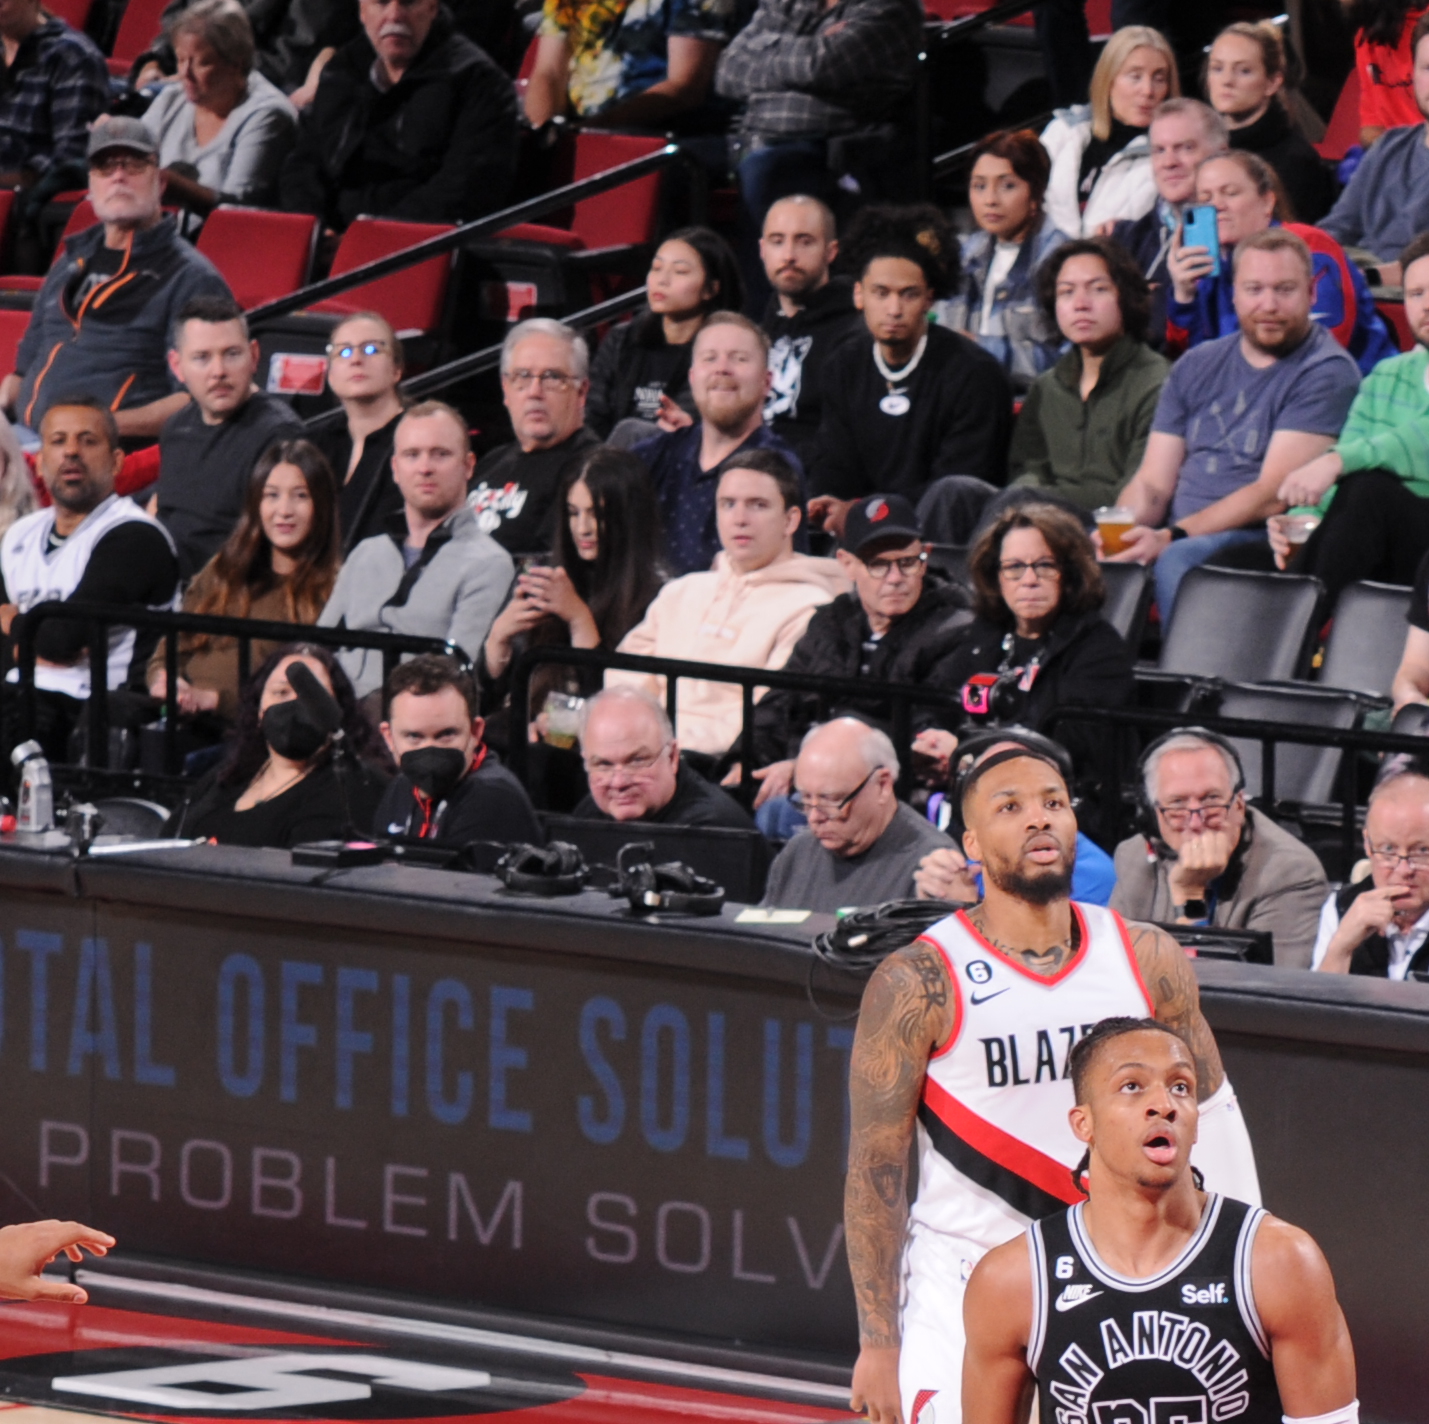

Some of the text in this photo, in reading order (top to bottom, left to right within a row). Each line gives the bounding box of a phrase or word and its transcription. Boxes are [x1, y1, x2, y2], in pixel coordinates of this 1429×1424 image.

[0, 928, 177, 1087] TAL
[216, 952, 535, 1133] OFFICE
[977, 1023, 1094, 1088] BLAZ
[39, 1119, 524, 1251] PROBLEM
[1055, 1255, 1075, 1279] 6
[1062, 1283, 1094, 1301] NIKE
[1099, 1309, 1250, 1423] ANTONIO
